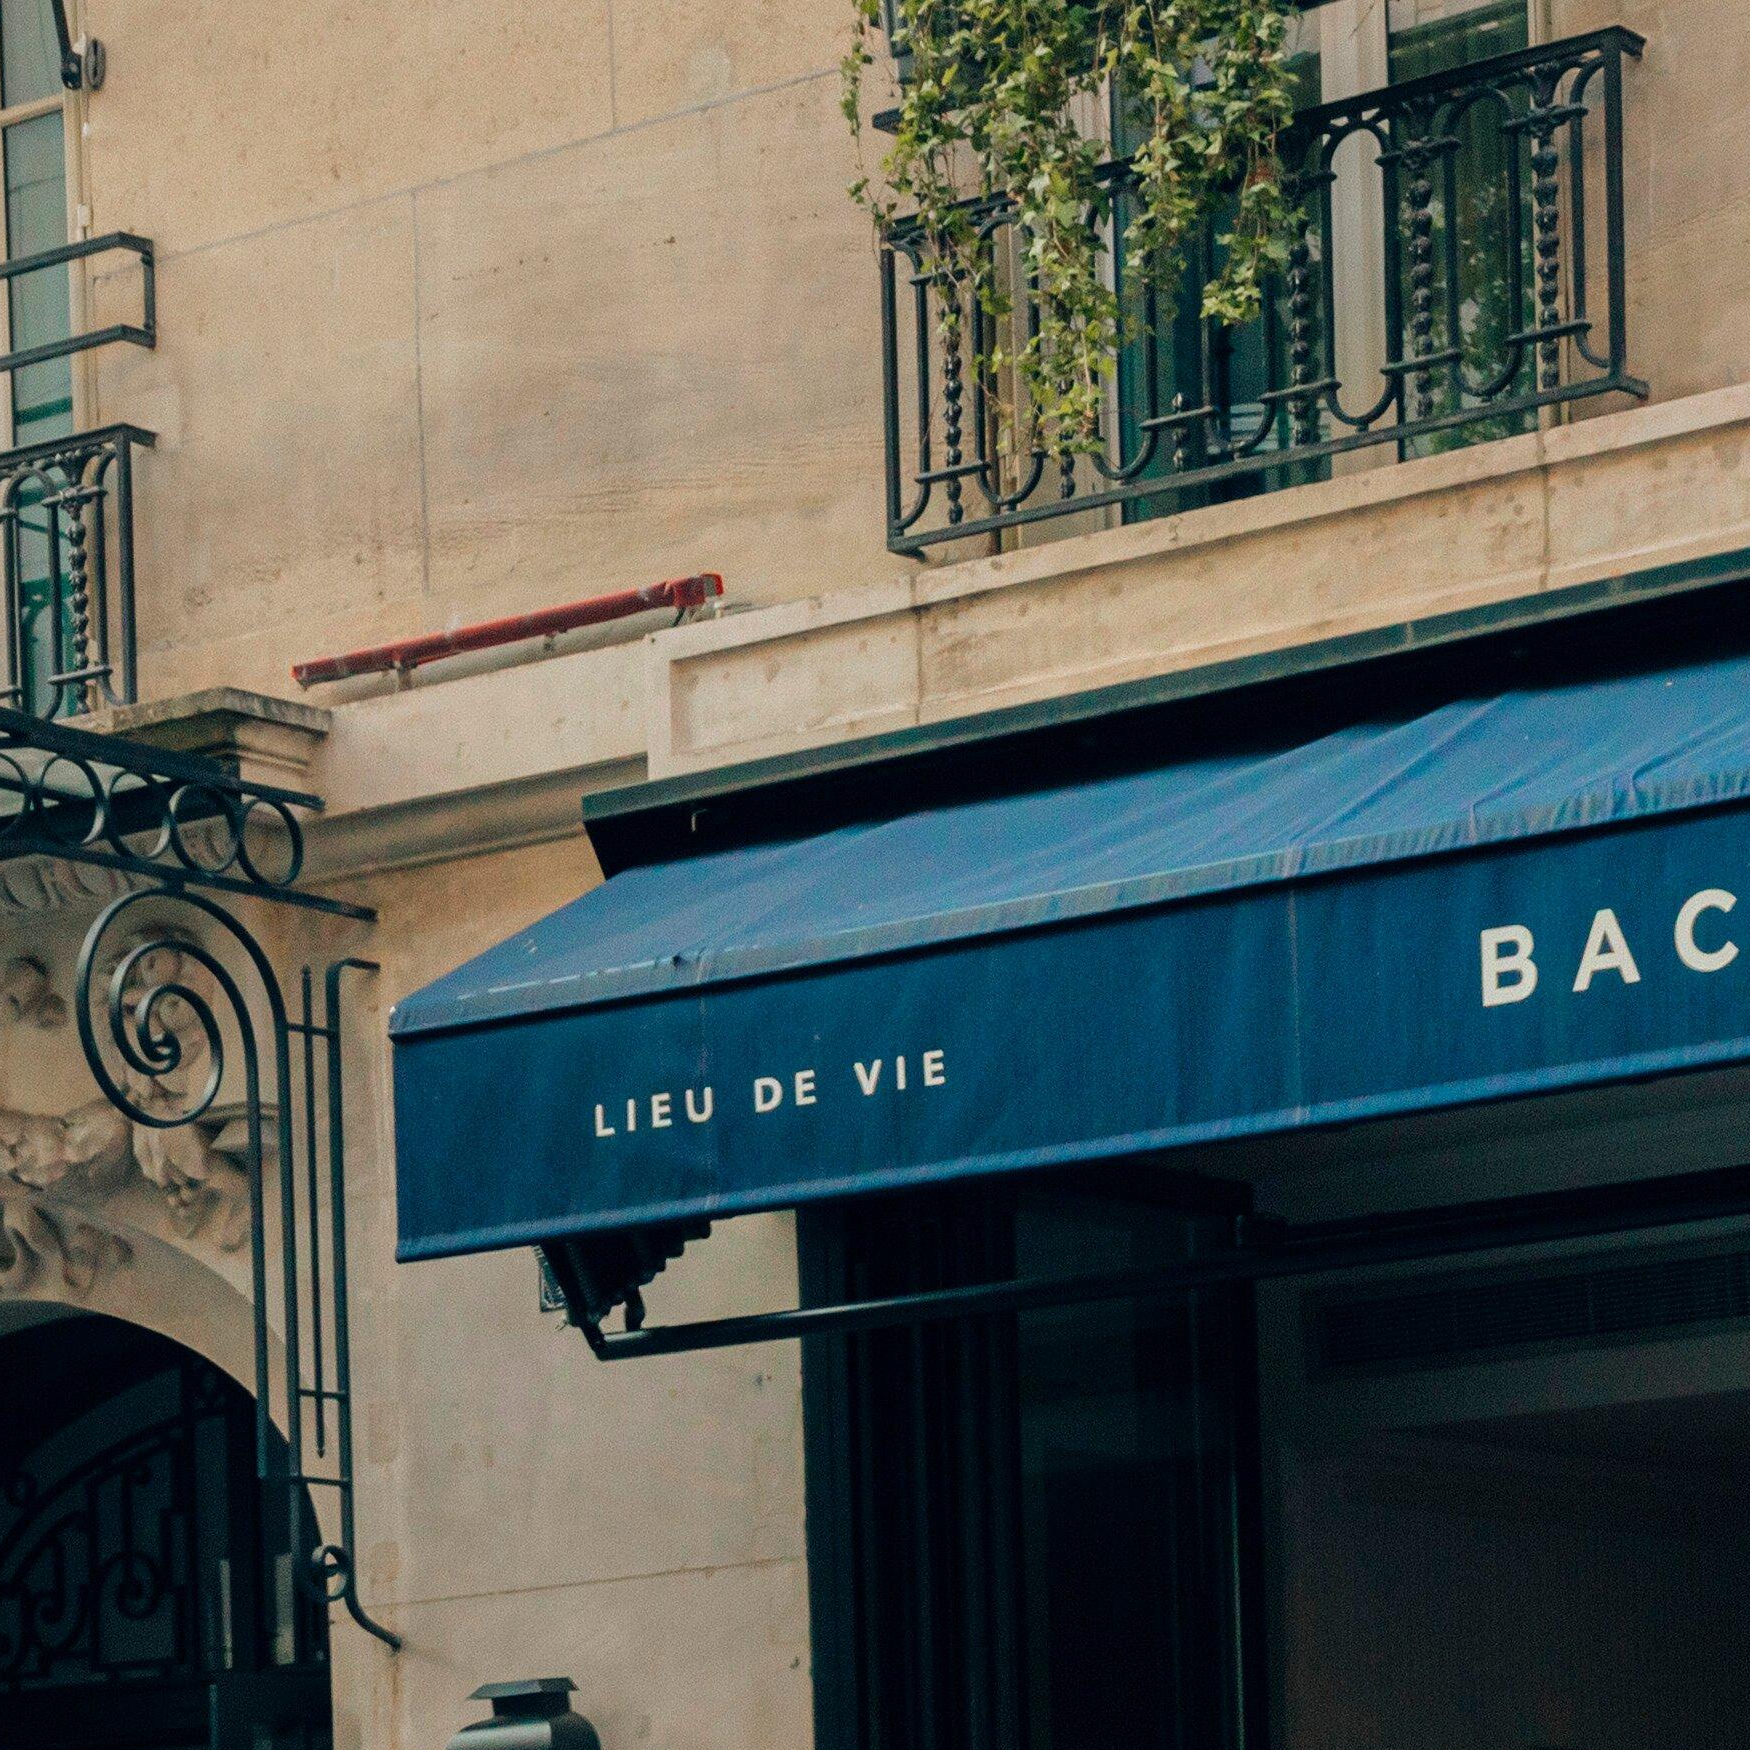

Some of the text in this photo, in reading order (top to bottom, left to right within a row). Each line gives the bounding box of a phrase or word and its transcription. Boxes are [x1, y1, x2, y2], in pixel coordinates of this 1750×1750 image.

[594, 1049, 947, 1138] LIEU DE VIE
